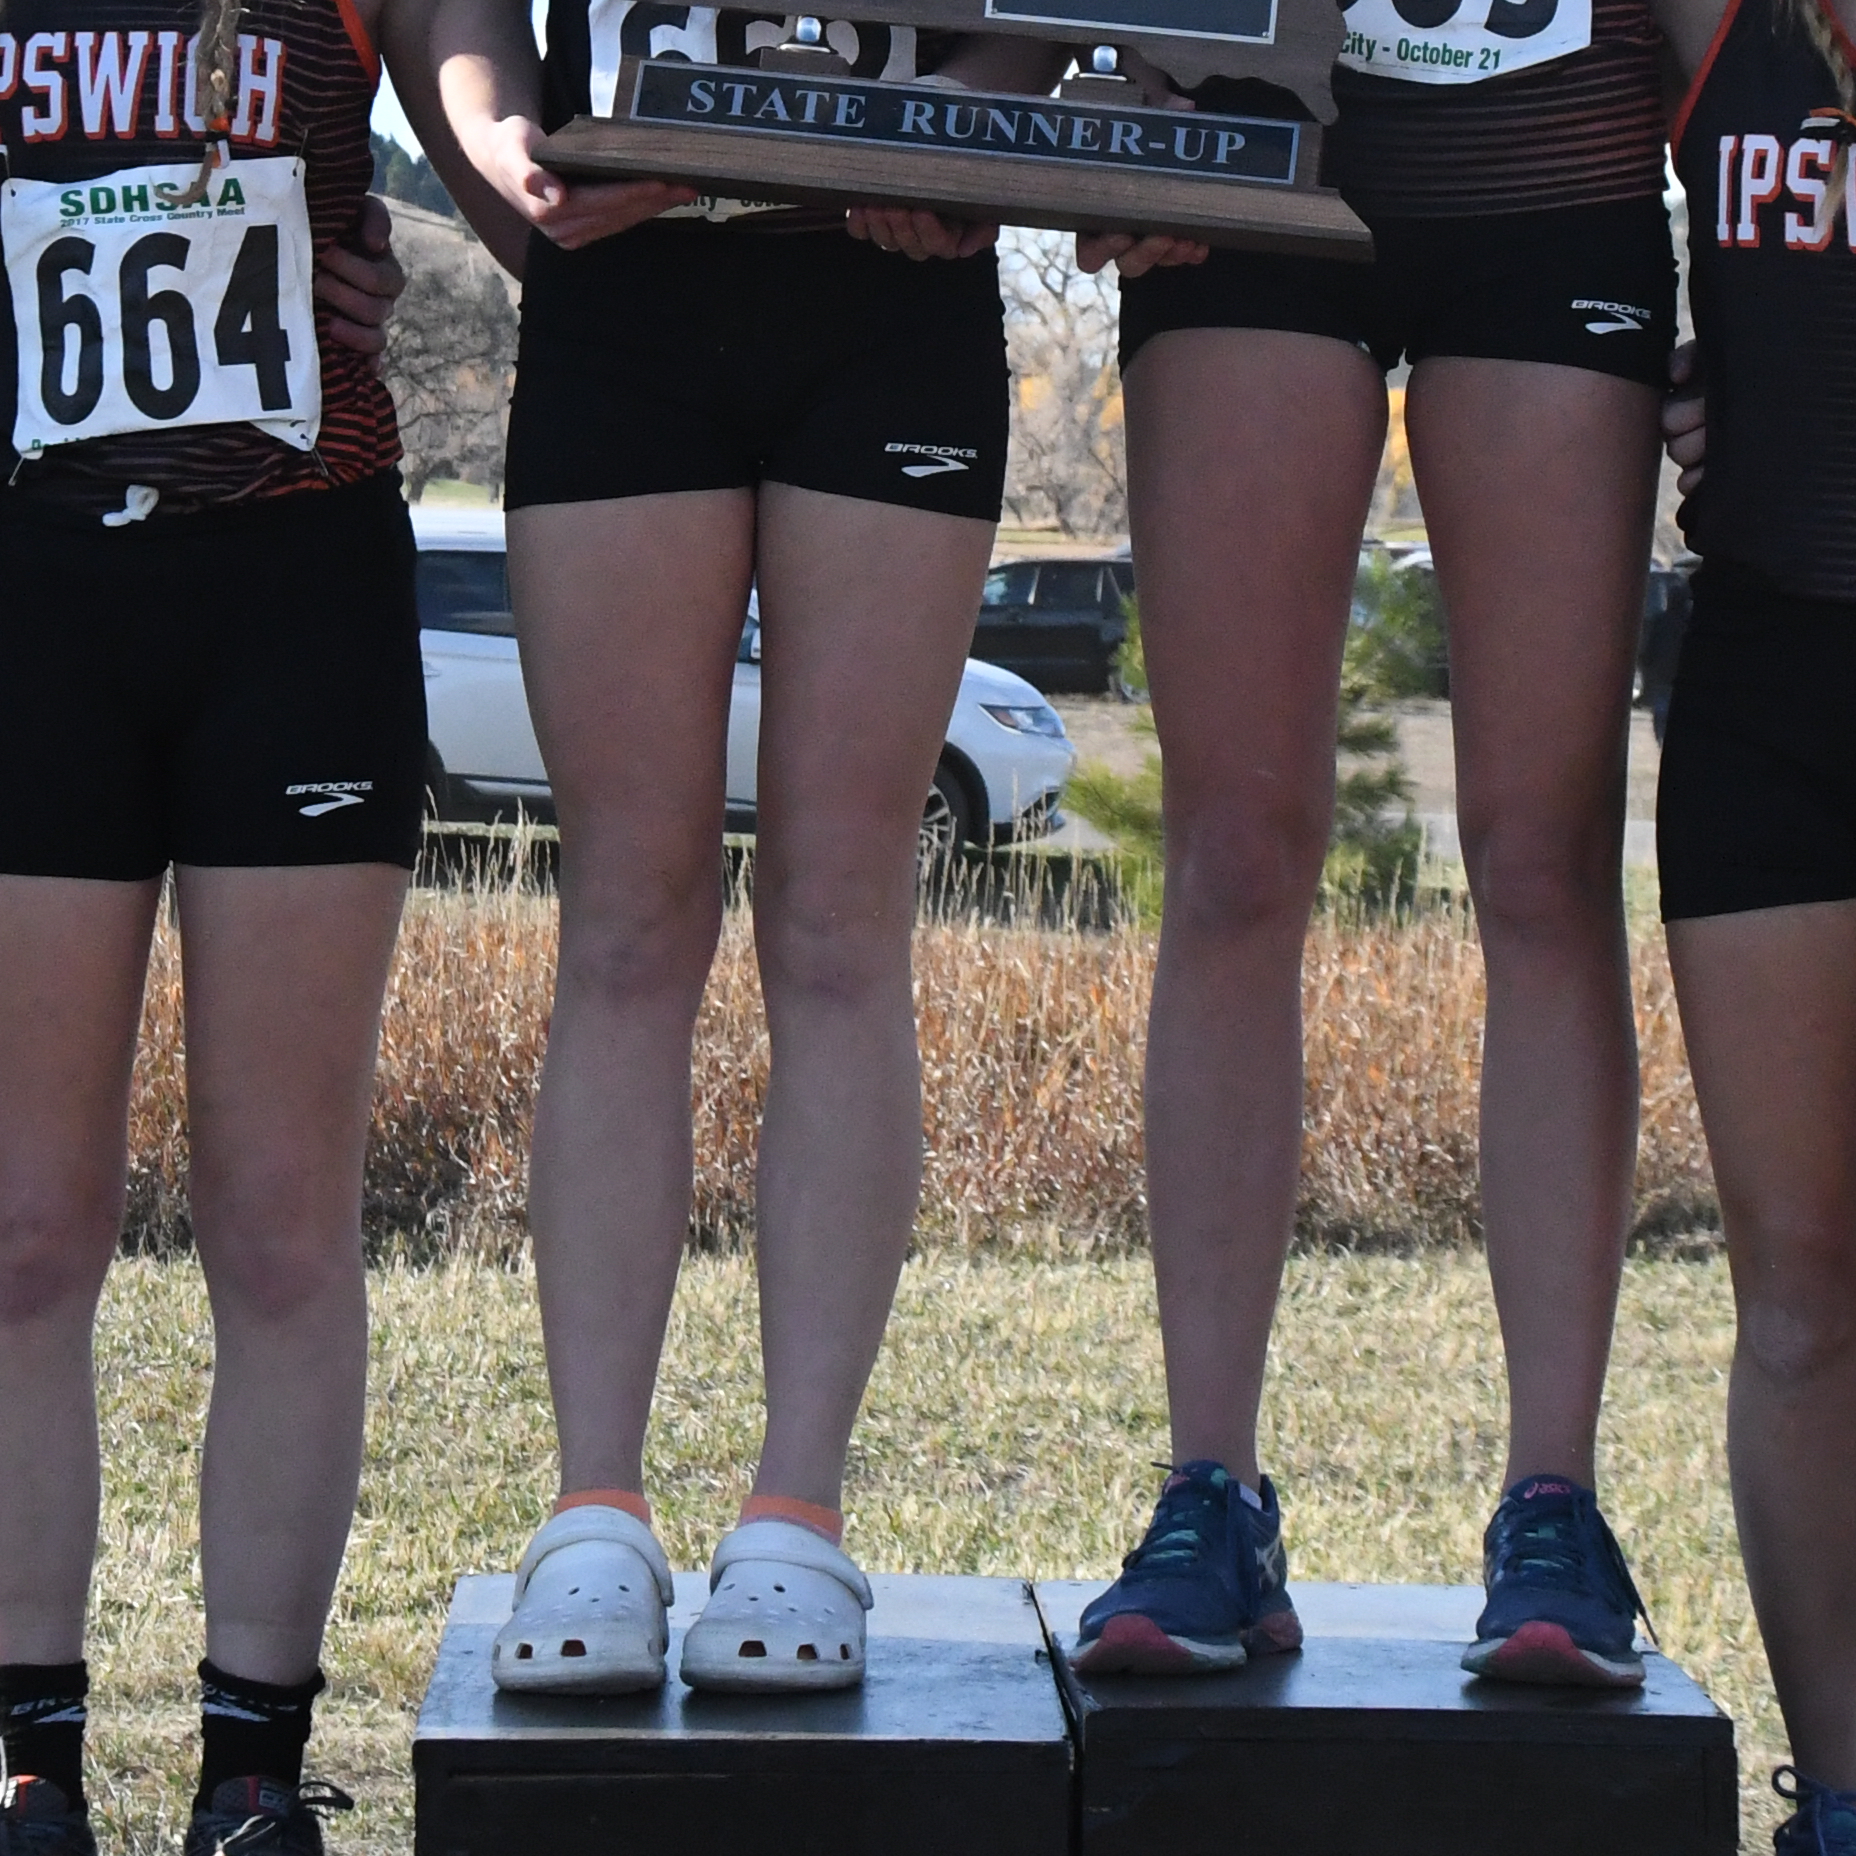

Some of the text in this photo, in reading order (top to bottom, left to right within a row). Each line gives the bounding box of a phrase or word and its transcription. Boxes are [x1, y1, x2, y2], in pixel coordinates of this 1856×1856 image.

[1396, 37, 1474, 68] October
[1478, 48, 1501, 70] 21
[686, 79, 1247, 165] STATE RUNNER-UP
[60, 218, 90, 228] 2017
[94, 216, 125, 225] State
[130, 214, 162, 223] Cross
[167, 210, 213, 221] Country
[1571, 299, 1652, 319] BROOKS
[37, 224, 292, 425] 664
[884, 443, 978, 459] BROOKS
[285, 781, 373, 795] BROOKS
